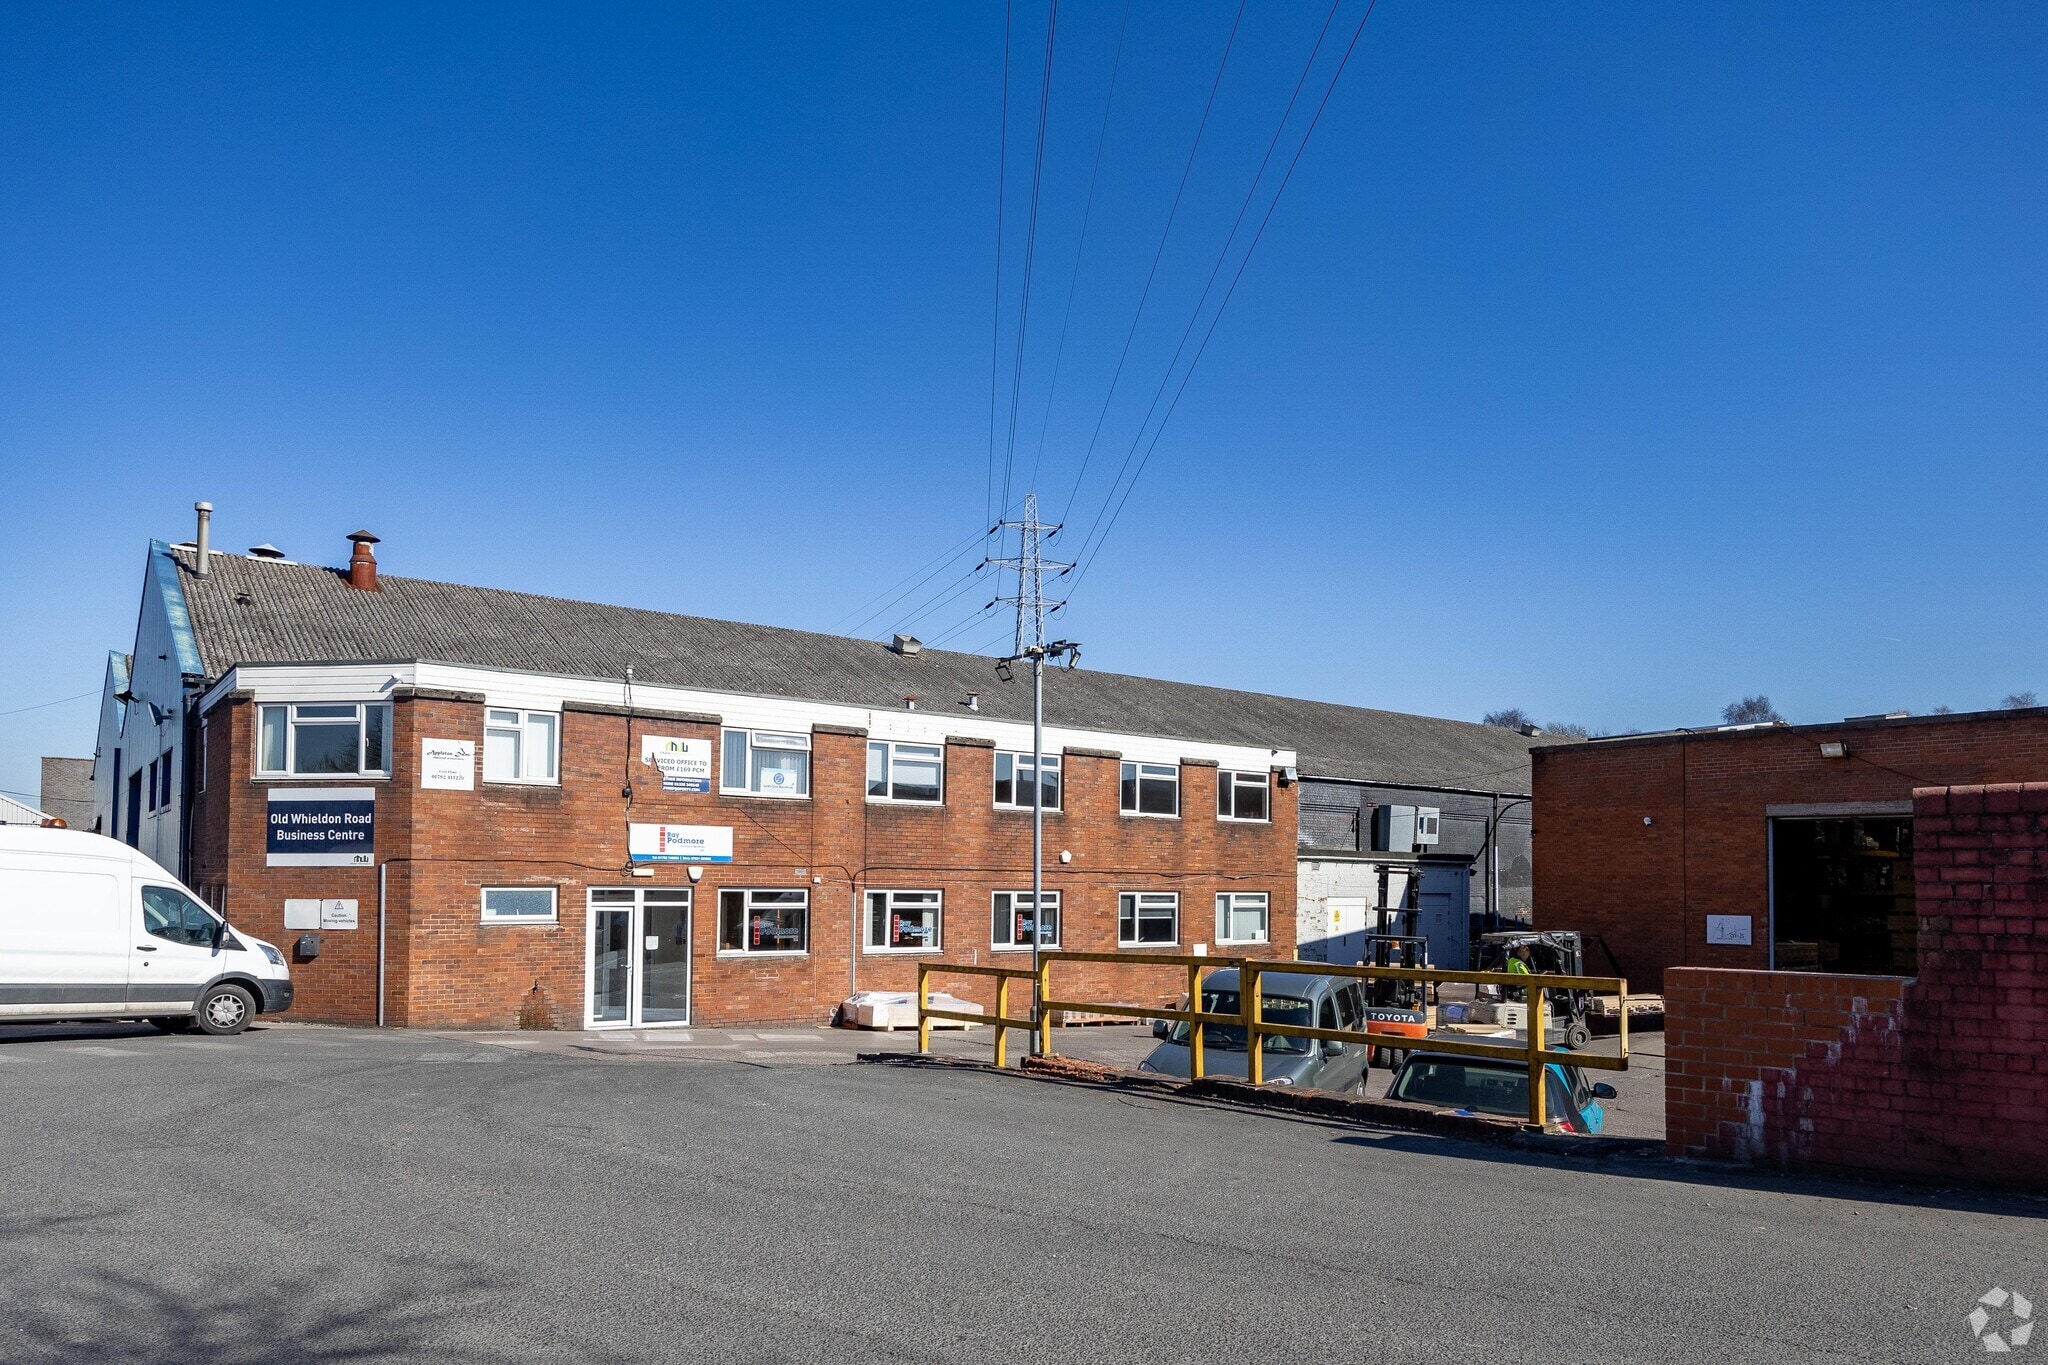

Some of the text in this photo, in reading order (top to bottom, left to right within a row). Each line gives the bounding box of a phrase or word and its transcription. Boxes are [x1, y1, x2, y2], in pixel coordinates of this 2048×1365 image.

[645, 757, 675, 765] SEVICED
[270, 812, 372, 824] Old Whieldon Road
[276, 829, 365, 840] Business Centre
[667, 831, 680, 839] Ray
[667, 837, 704, 845] Podmore
[1371, 1012, 1415, 1022] TOYOTA
